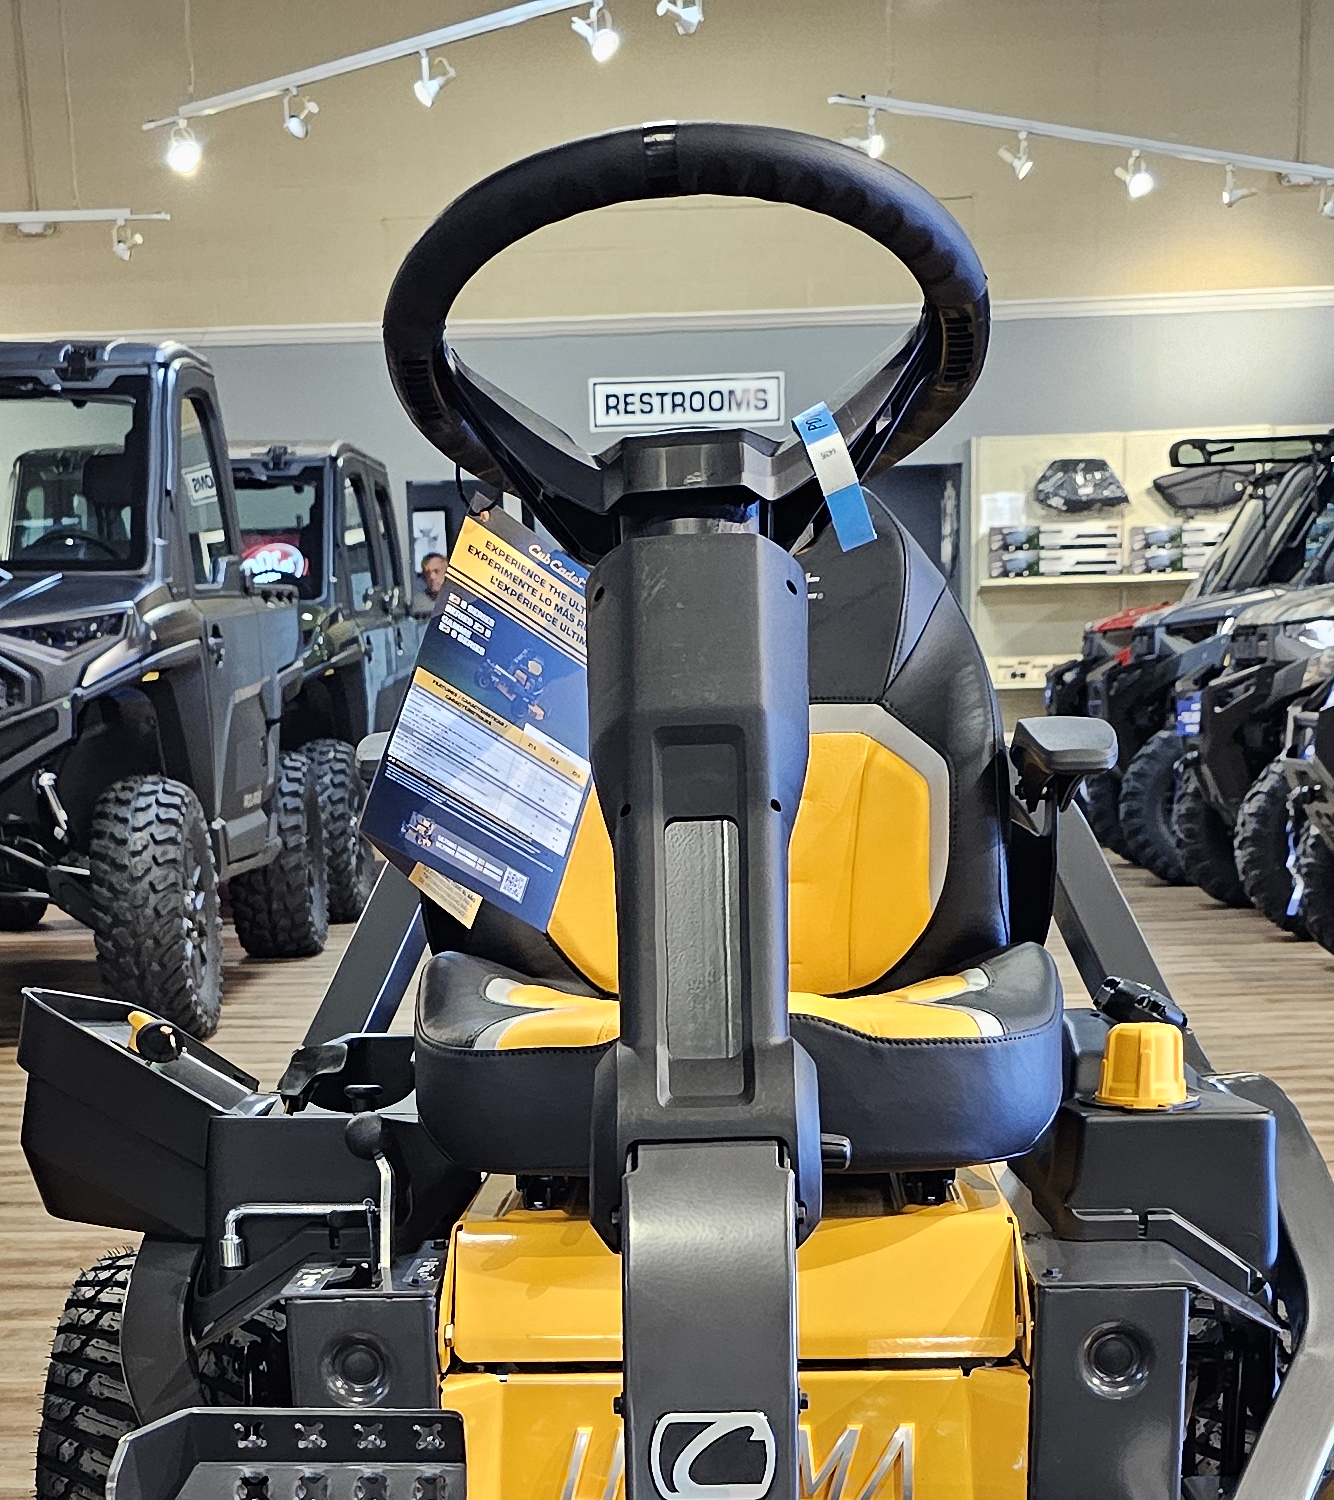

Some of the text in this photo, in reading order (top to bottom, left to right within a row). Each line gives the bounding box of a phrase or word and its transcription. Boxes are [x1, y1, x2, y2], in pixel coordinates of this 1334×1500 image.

[605, 387, 769, 417] RESTROOMS
[467, 544, 537, 597] EXPERIMENTE
[539, 592, 552, 607] LO
[553, 599, 575, 623] MÁS
[485, 539, 587, 615] EXPERIENCE THE ULT
[528, 543, 587, 588] Cub Cadet
[489, 575, 587, 647] L'EXPÉRIENCE ULTIM
